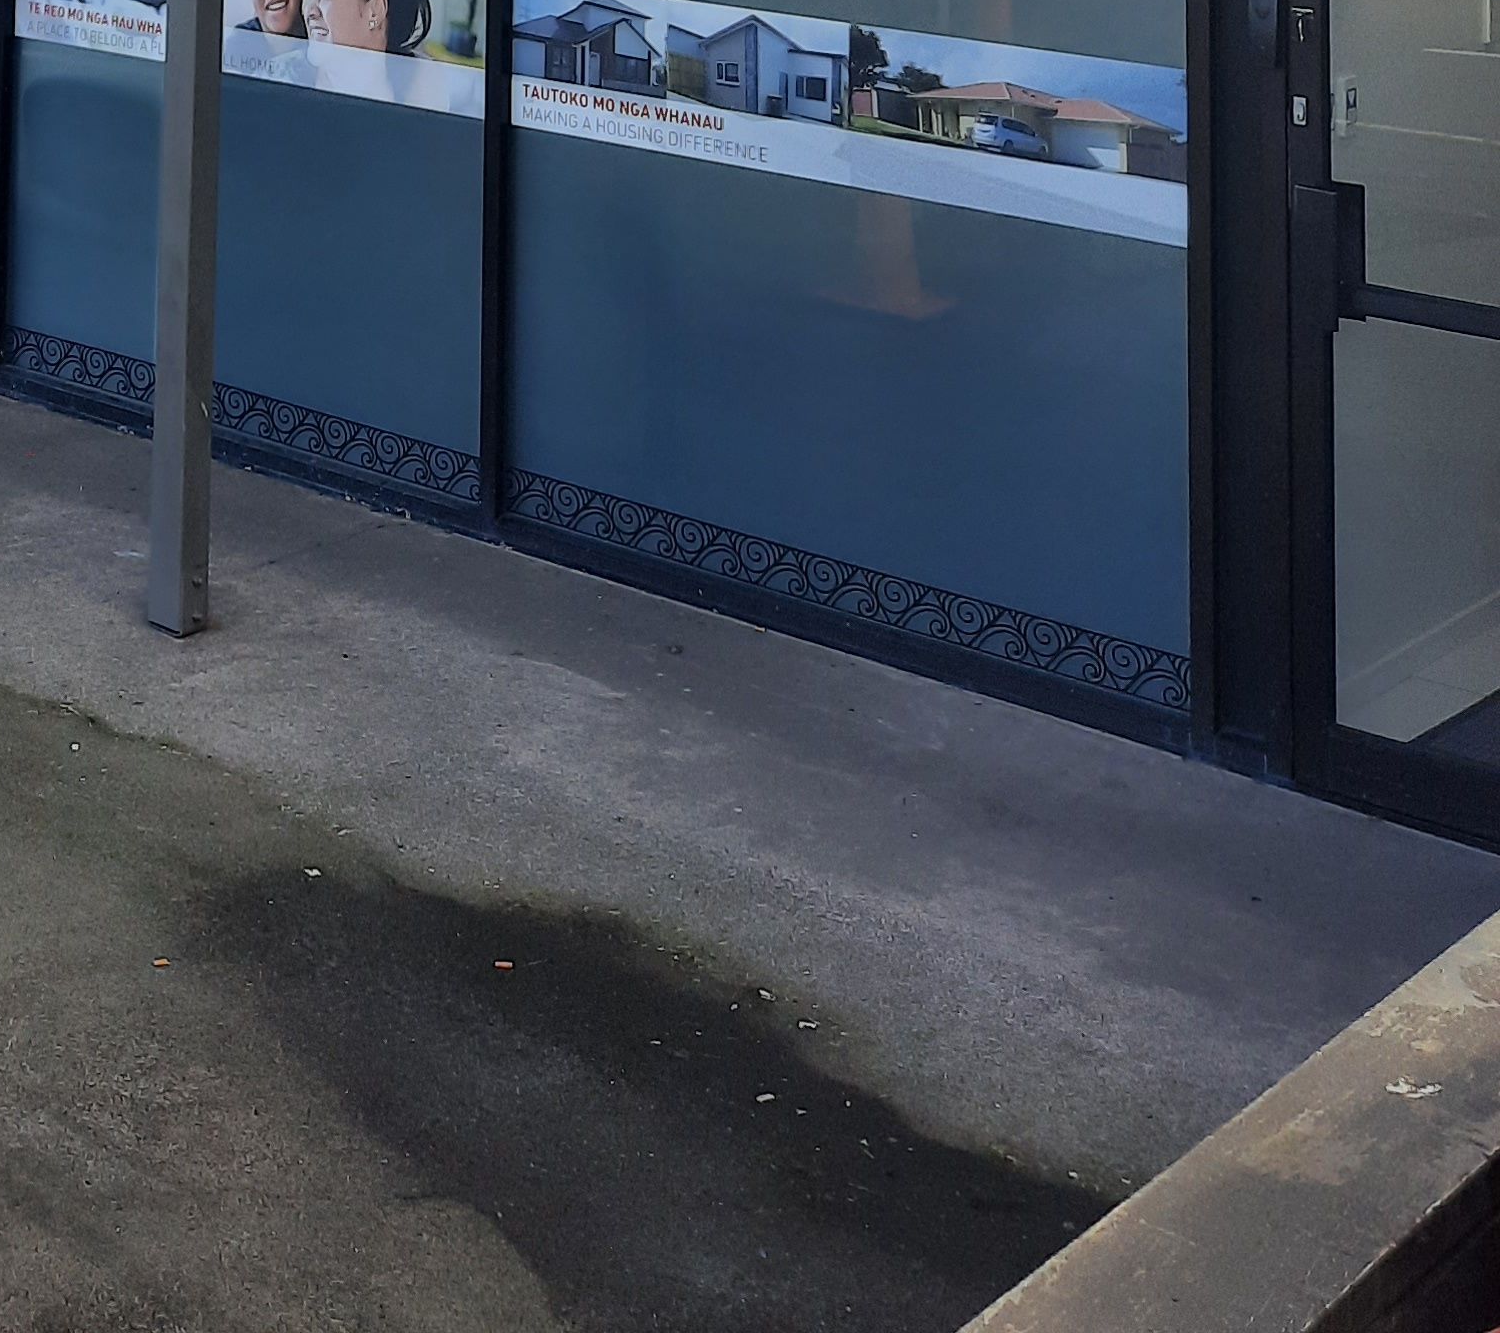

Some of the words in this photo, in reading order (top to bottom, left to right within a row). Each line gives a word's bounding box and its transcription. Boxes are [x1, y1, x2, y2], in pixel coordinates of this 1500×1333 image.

[27, 1, 41, 15] TE
[44, 3, 65, 19] REO
[67, 7, 84, 23] MO
[86, 10, 109, 26] NGA
[111, 16, 135, 31] HAU
[137, 19, 163, 36] WHA
[37, 21, 70, 39] PLACE
[522, 83, 589, 109] TAUTOKO
[593, 95, 615, 113] MO
[619, 99, 650, 119] NGA
[654, 106, 725, 132] WHANAU
[522, 105, 578, 130] MAKING
[582, 116, 593, 132] A
[596, 118, 664, 145] HOUSING
[668, 131, 769, 164] DIFFERENCE
